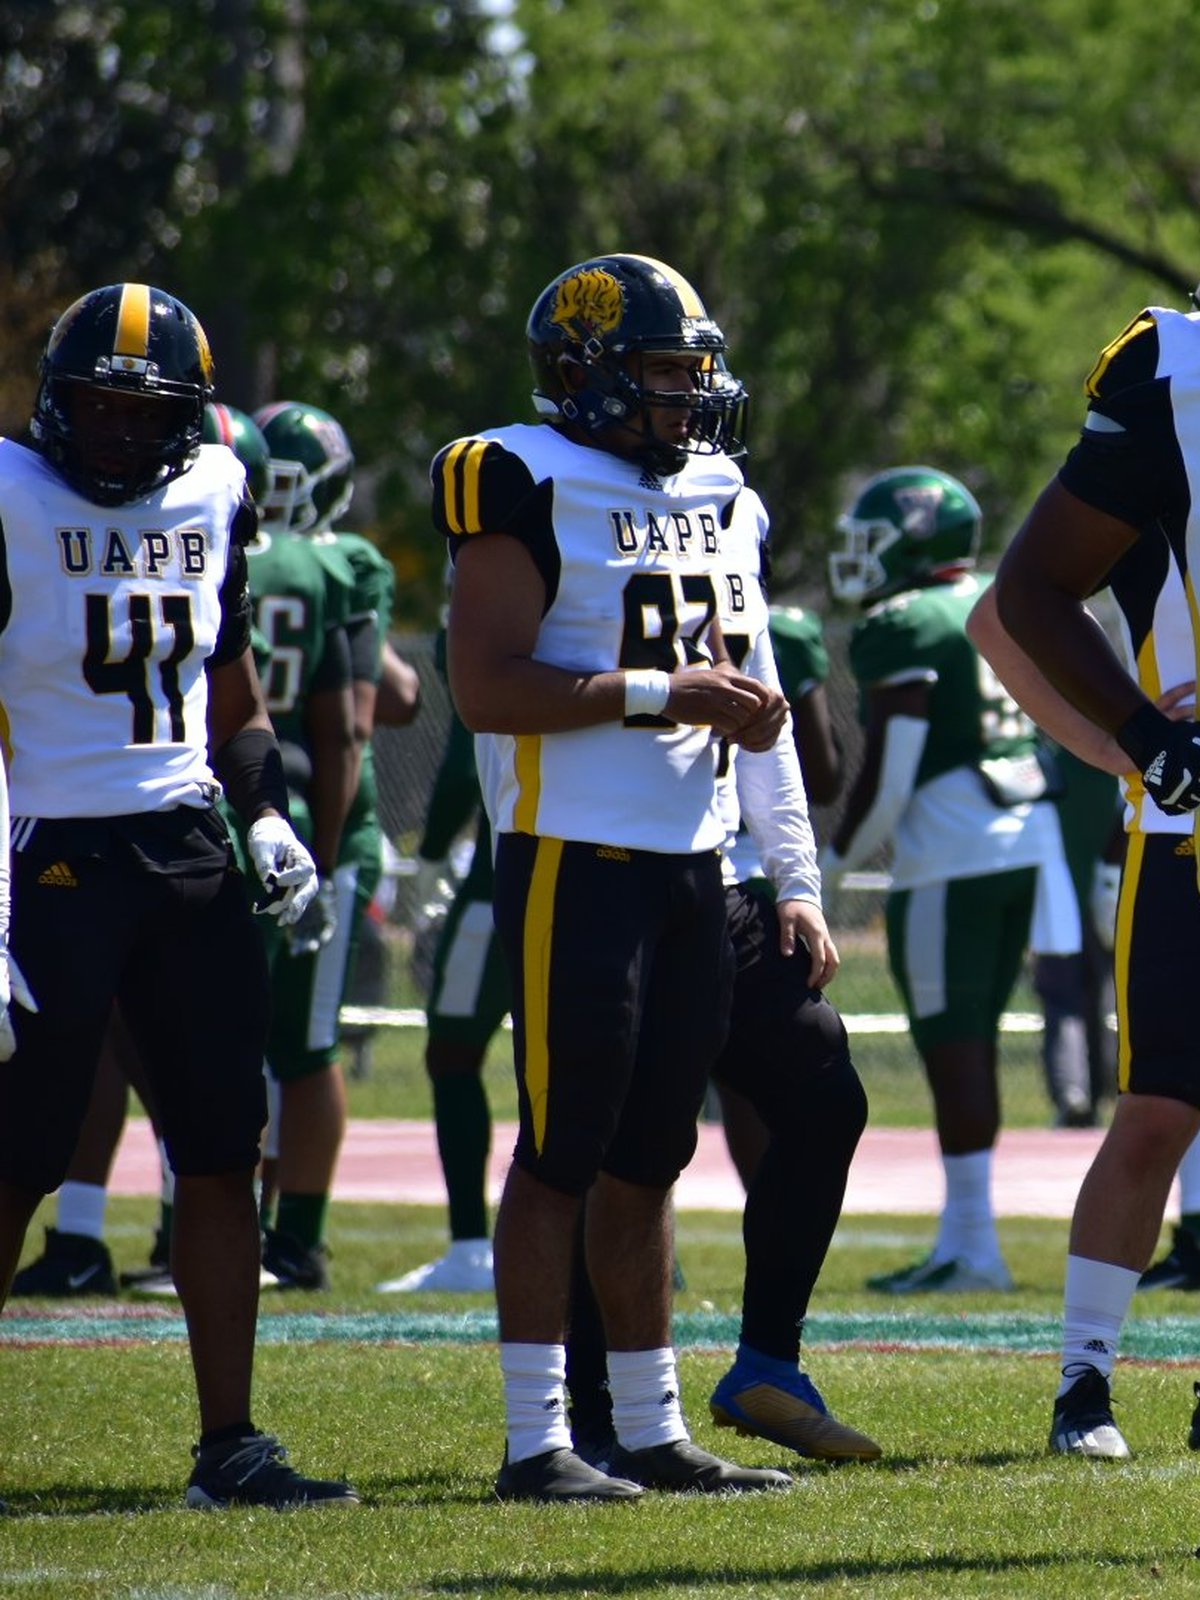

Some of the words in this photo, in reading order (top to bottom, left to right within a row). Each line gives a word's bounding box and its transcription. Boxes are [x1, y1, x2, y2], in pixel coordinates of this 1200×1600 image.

[56, 527, 209, 579] UAPB
[608, 508, 720, 556] UAPB
[82, 594, 194, 743] 41
